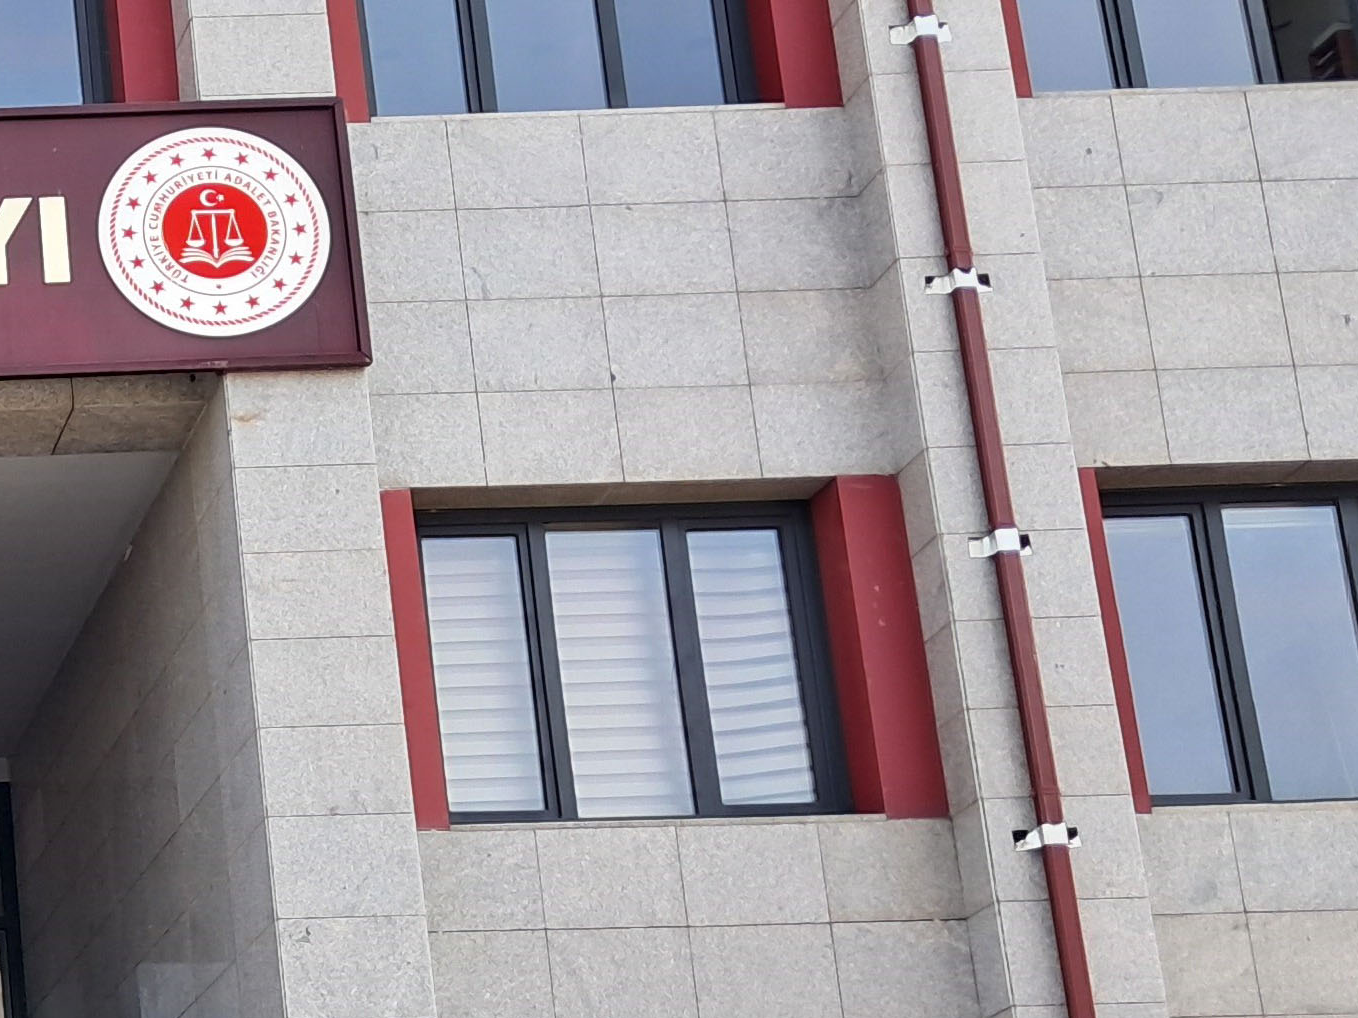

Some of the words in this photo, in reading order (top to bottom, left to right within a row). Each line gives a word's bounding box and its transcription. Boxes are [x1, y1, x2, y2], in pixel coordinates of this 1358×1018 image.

[149, 170, 217, 230] CUMHURİYETİ
[225, 173, 271, 205] ADALET
[150, 236, 188, 283] TÜRKİYE
[251, 211, 281, 278] BAKANLIĞI
